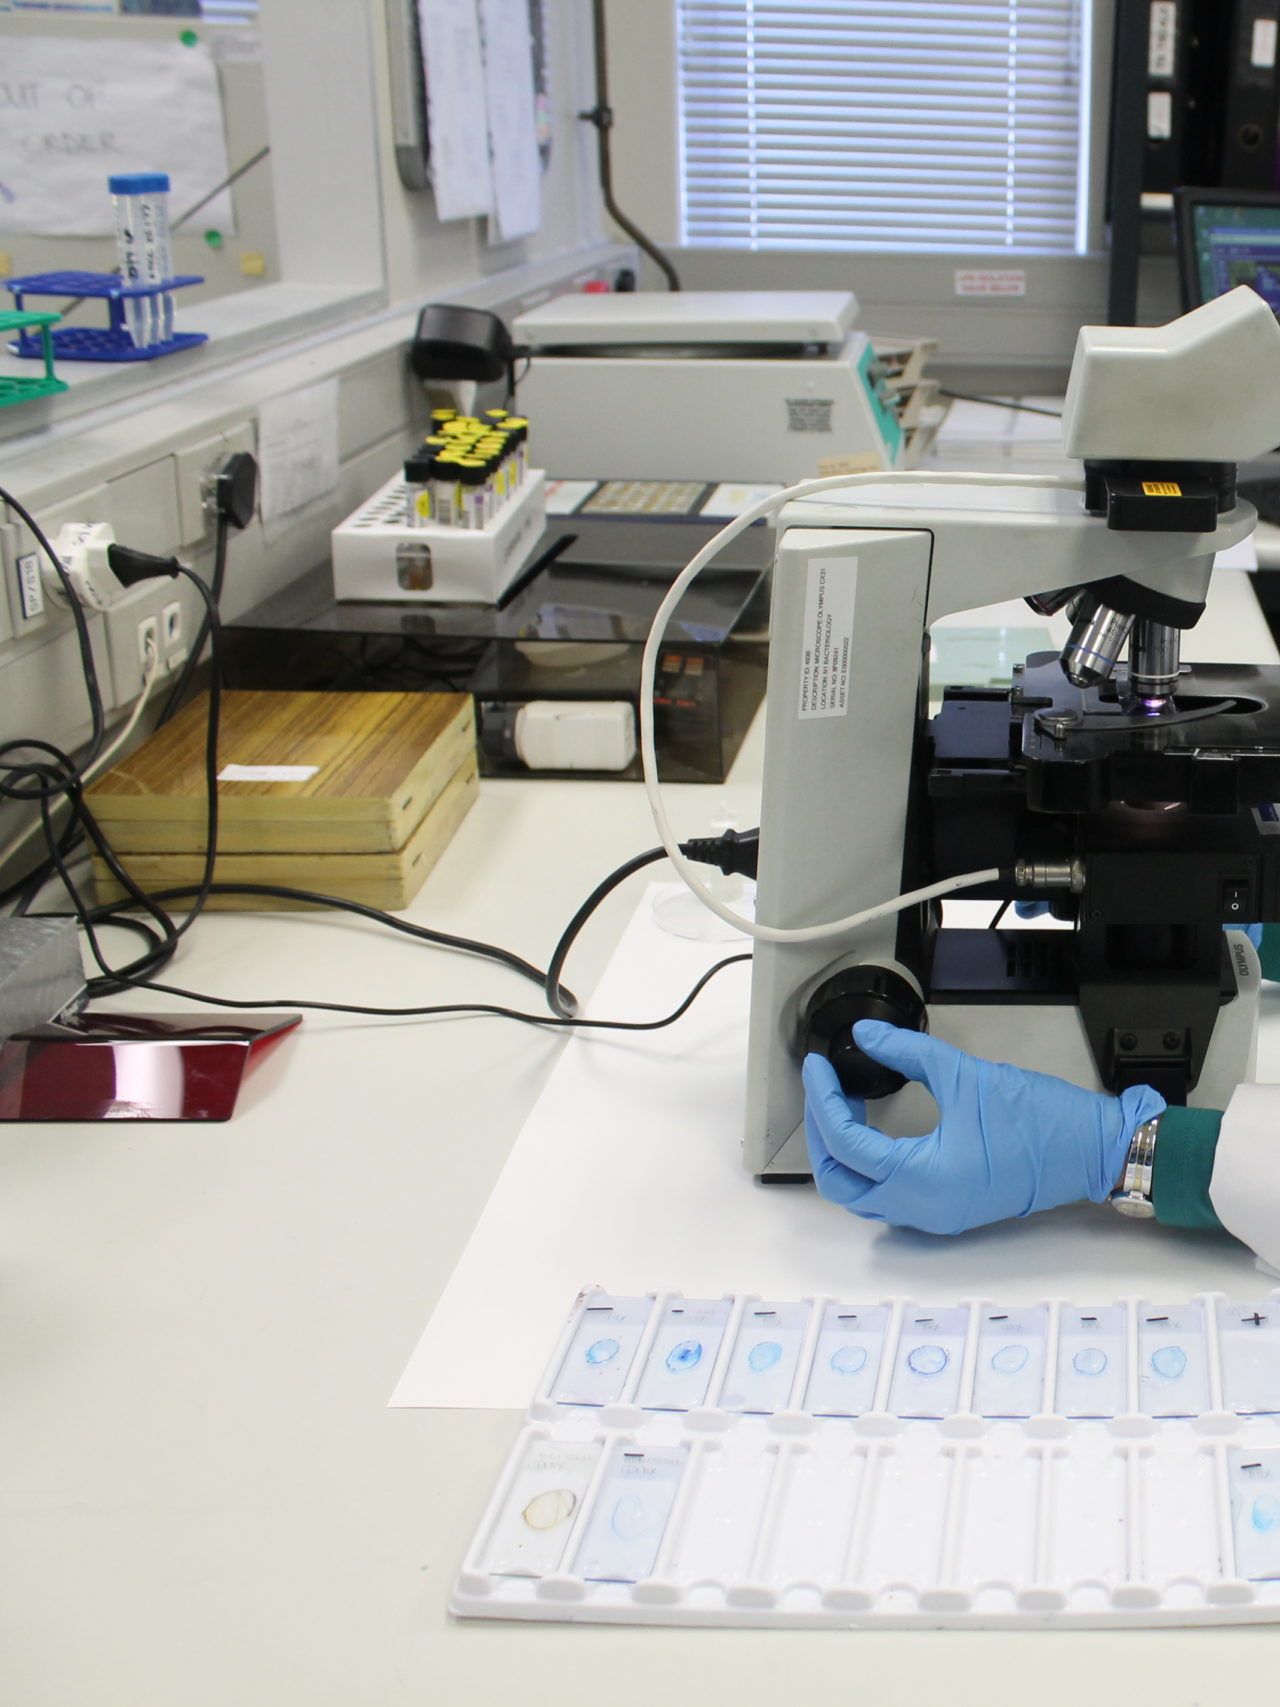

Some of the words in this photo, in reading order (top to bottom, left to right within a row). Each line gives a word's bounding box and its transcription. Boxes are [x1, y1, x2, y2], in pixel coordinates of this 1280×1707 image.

[817, 585, 825, 619] OLYMPUS
[814, 619, 822, 664] MICROSCOPE
[824, 613, 832, 665] BACTERIOLOGY
[1233, 943, 1249, 977] OLYMPUS
